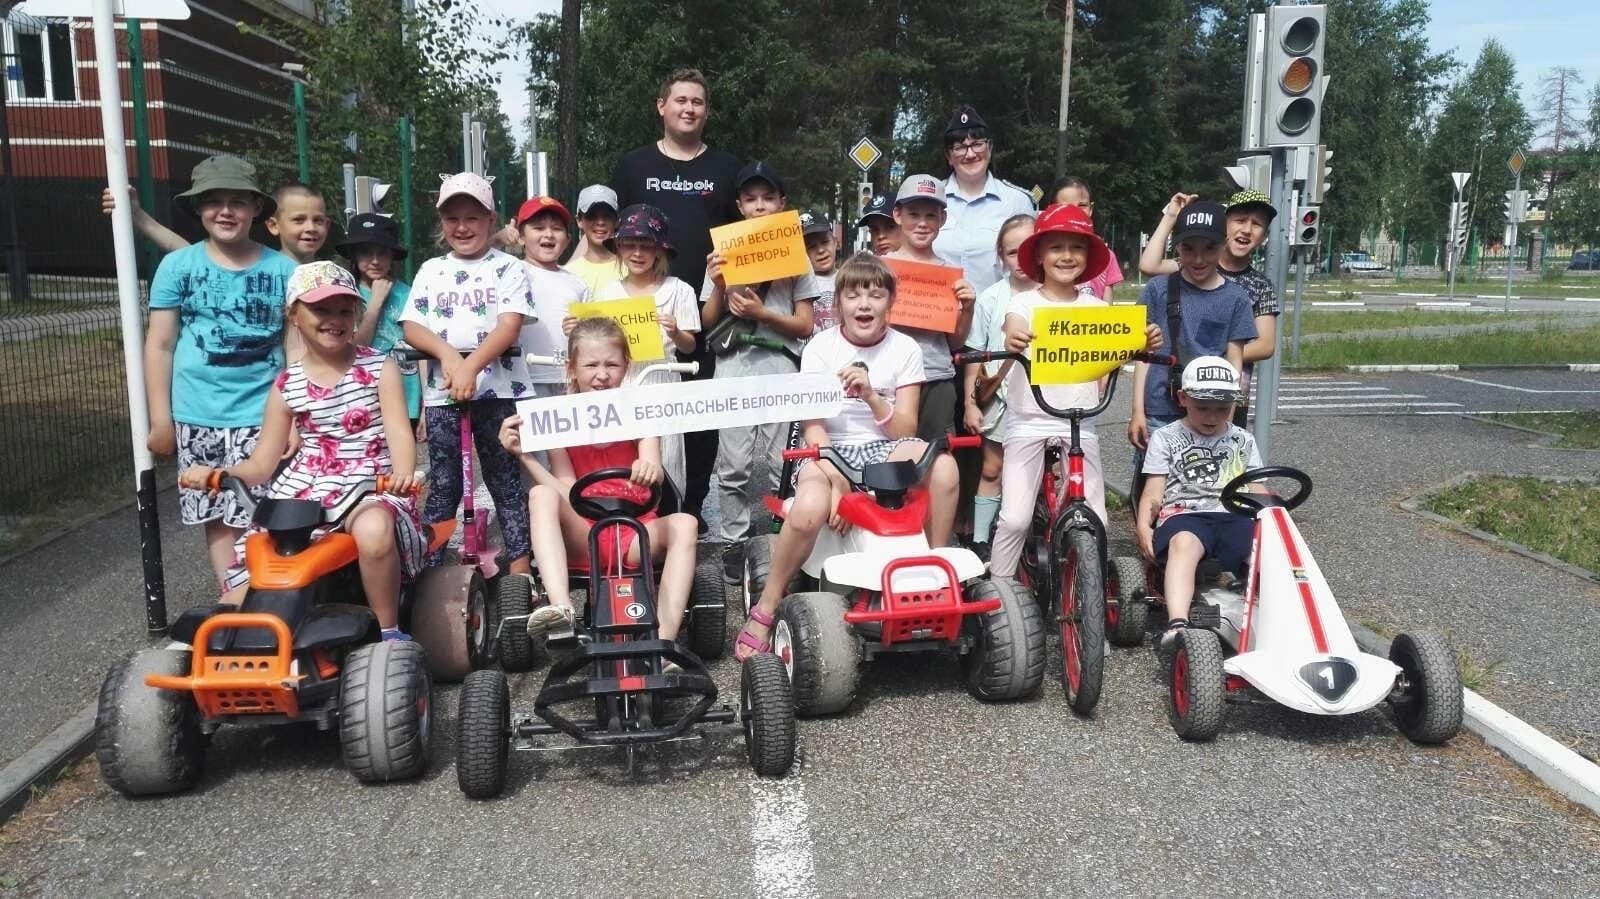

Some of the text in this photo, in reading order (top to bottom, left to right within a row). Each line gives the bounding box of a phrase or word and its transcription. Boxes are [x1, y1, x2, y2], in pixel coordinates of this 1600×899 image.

[1186, 212, 1213, 226] ICON
[720, 224, 801, 251] ДЛЯ ВЕСЕЛОЙ
[735, 246, 790, 268] ДЕТВОРЫ
[436, 287, 497, 308] GRAPE
[1049, 320, 1131, 336] #Катаюсь
[1036, 347, 1140, 366] ПоПравилам
[1198, 367, 1232, 381] FUNNY
[530, 390, 841, 436] МЫ ЗА БЕЗОПАСНЫЕ ВЕЛОПРОГУЛКИ!
[631, 606, 638, 615] 1
[1318, 666, 1335, 690] 1
